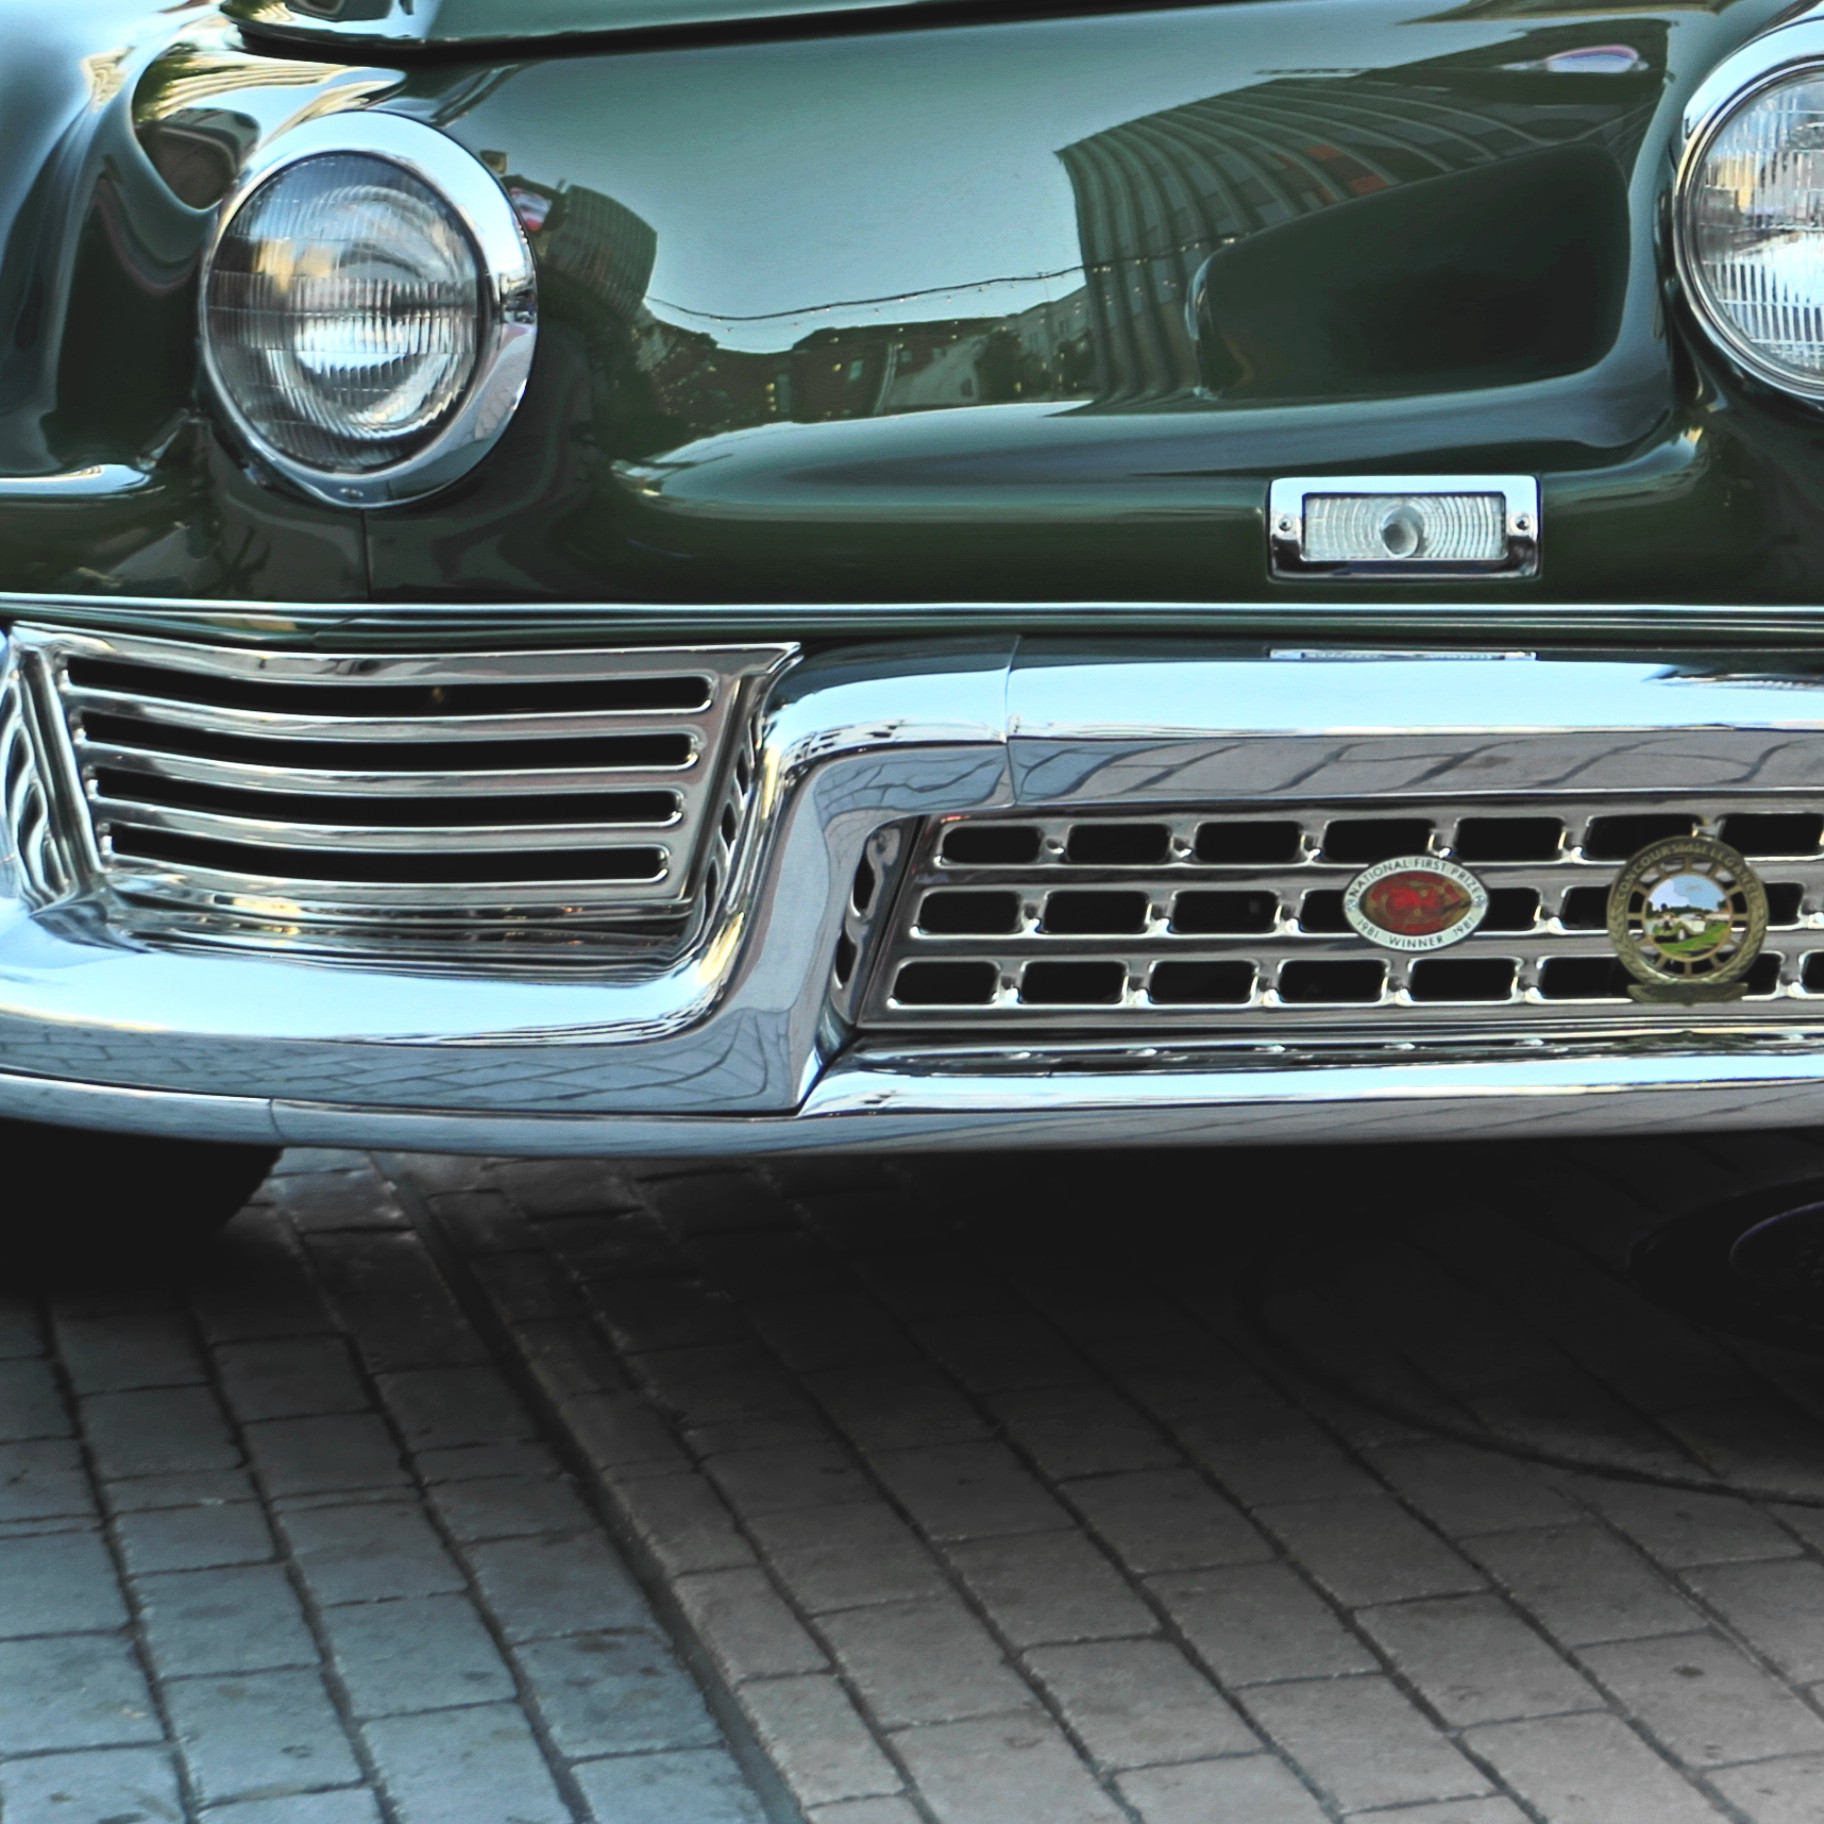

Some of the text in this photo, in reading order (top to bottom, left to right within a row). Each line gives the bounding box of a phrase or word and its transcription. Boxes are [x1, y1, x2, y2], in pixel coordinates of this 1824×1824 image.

[1348, 858, 1482, 899] NATIONAL FIRST PRIZE
[1357, 917, 1476, 948] 1981 WINNER 1981
